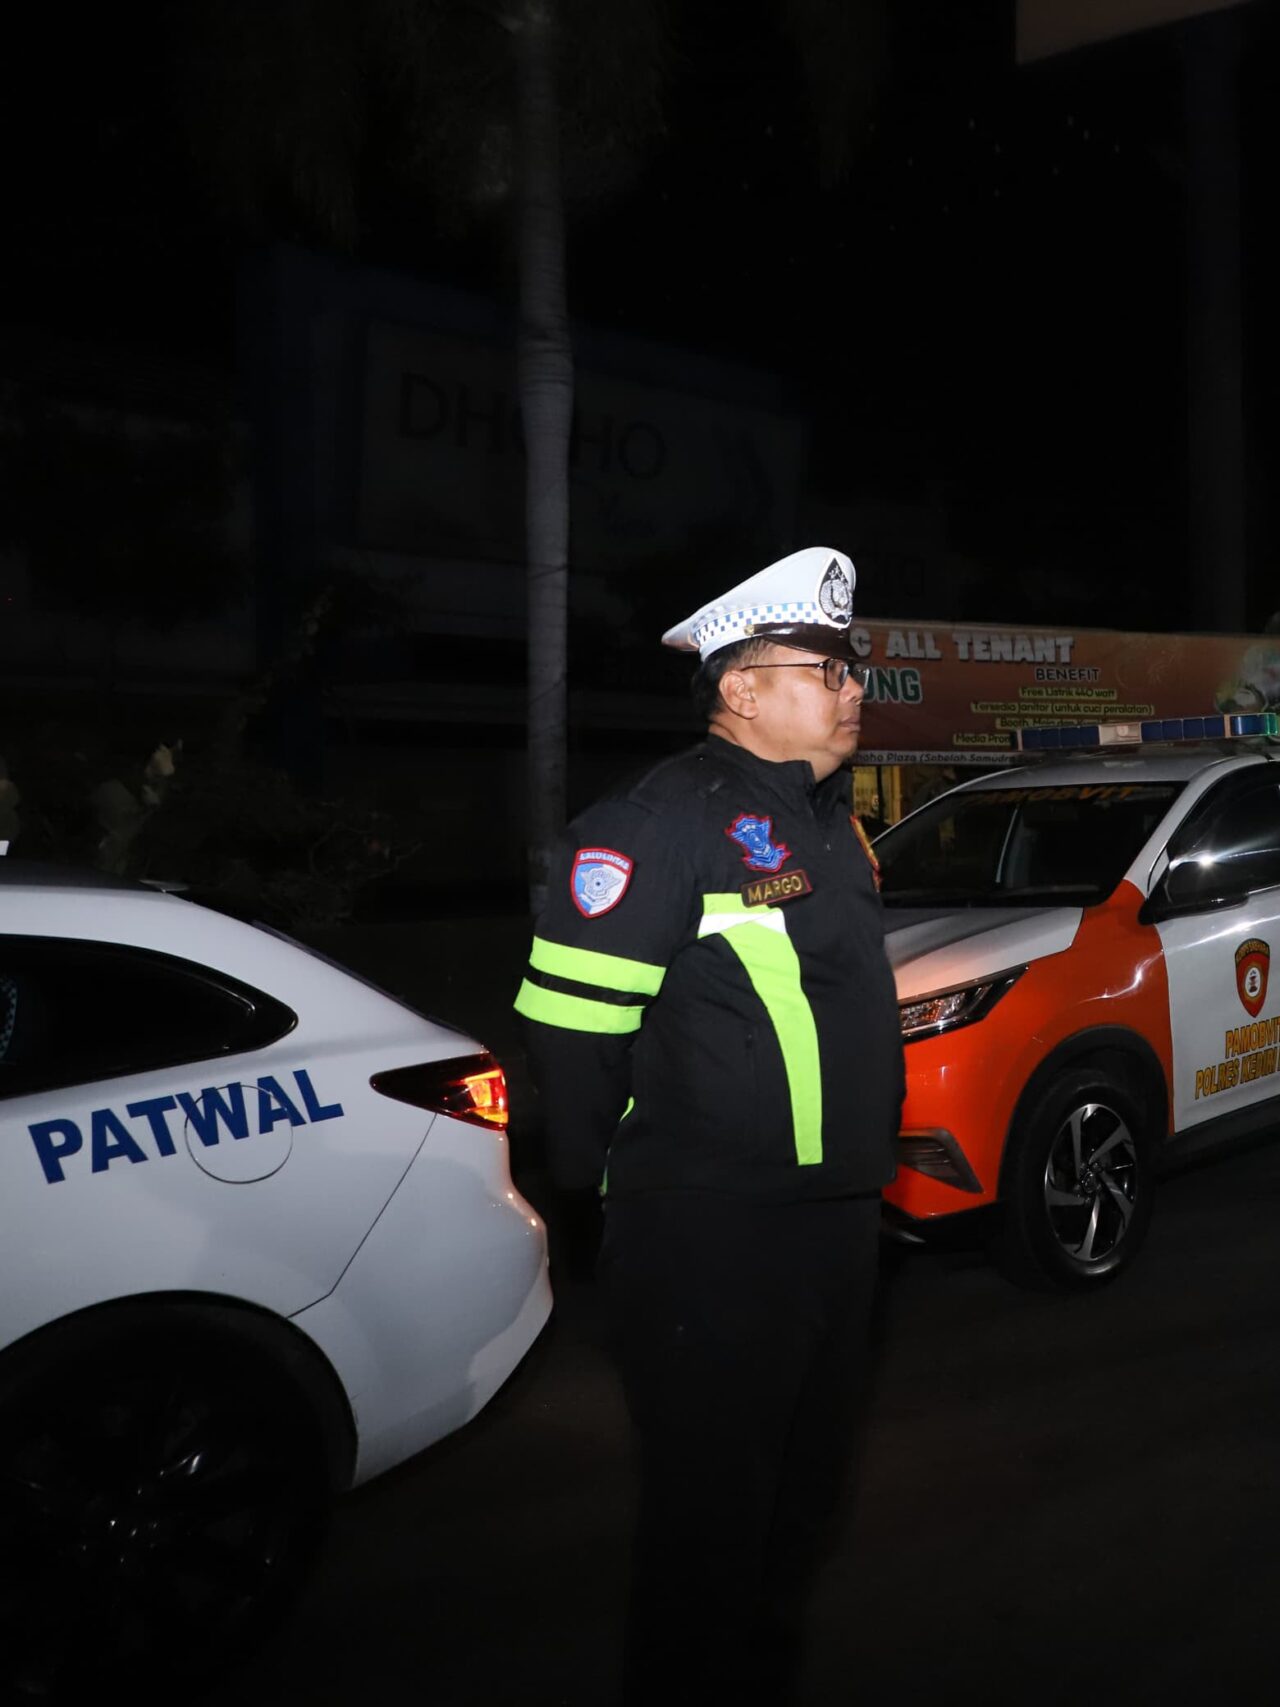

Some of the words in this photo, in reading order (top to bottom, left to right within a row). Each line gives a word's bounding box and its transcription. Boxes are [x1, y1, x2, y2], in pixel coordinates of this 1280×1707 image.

[886, 630, 942, 659] ALL
[952, 632, 1075, 664] TENANT
[1035, 668, 1100, 681] BENEFIT
[1020, 687, 1044, 698] Free
[1051, 703, 1081, 714] (untuk
[1083, 704, 1101, 713] cuci
[956, 733, 986, 744] Media
[747, 874, 803, 903] MARGO
[1195, 1058, 1240, 1100] POLRES
[1240, 1046, 1278, 1084] KEDIRI
[27, 1068, 345, 1184] PATWAL
